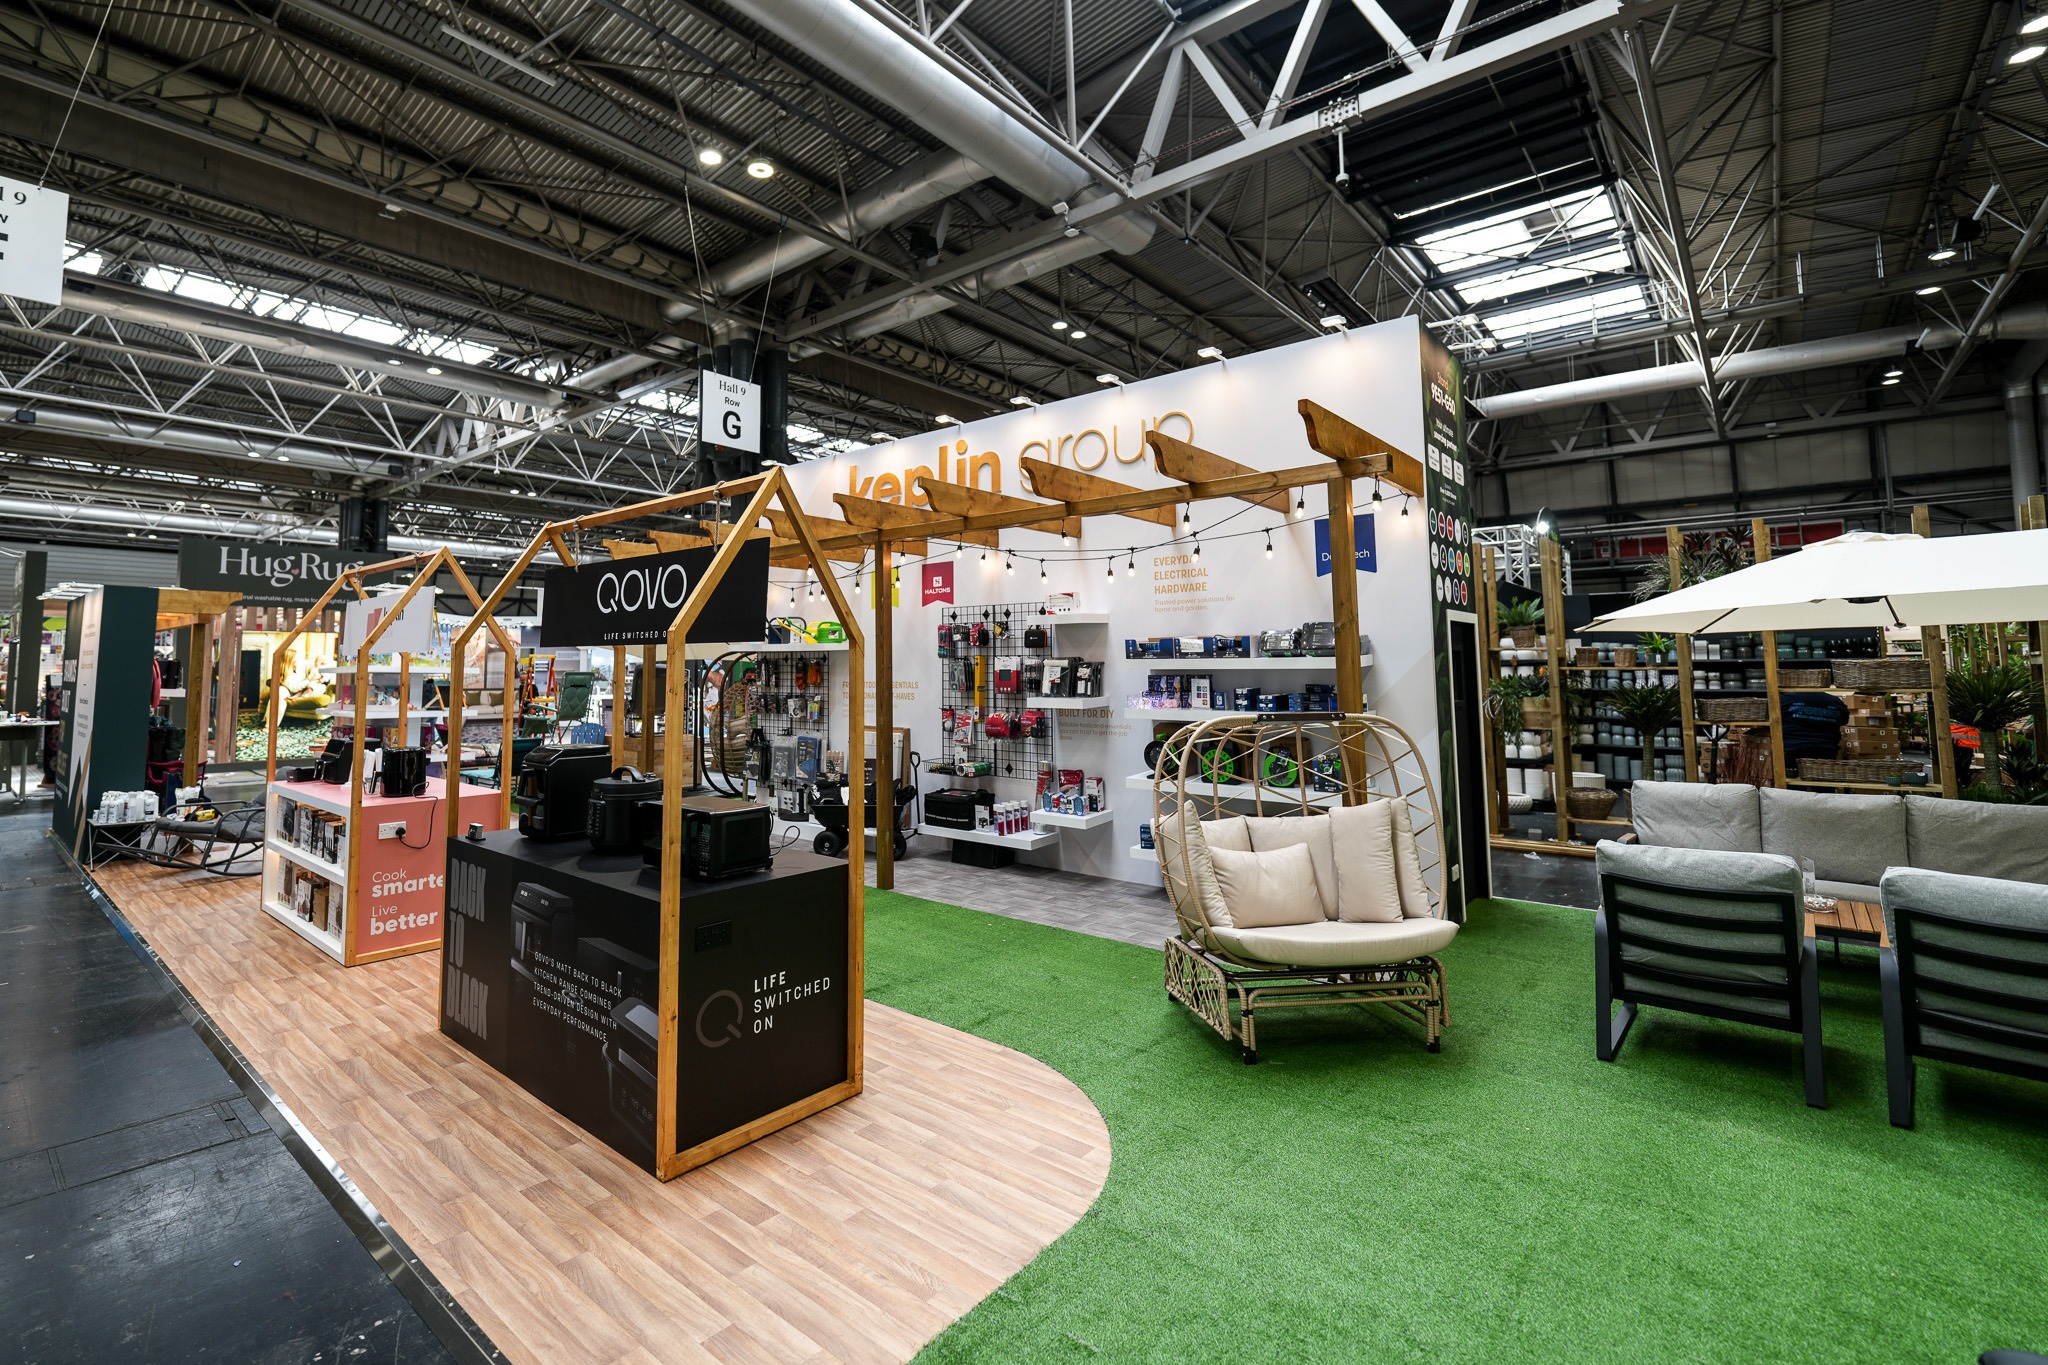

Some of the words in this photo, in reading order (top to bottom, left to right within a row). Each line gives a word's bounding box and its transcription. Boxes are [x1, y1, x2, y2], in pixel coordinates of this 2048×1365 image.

[719, 380, 738, 394] Hall
[740, 387, 746, 396] 9
[724, 396, 741, 408] Row
[722, 410, 742, 440] G
[849, 439, 1001, 508] keplin
[219, 546, 296, 588] Hug
[1154, 568, 1209, 580] ELECTRICAL
[597, 564, 687, 614] QOVO
[924, 587, 951, 595] HALTONS
[1154, 582, 1208, 594] HARDWARE
[1176, 599, 1197, 607] power
[604, 632, 619, 640] LIFE
[622, 631, 659, 640] SWITCHED
[1059, 709, 1080, 717] BUILT
[1082, 709, 1098, 718] FOR
[1100, 709, 1115, 718] DIY
[372, 868, 407, 883] Cook
[450, 857, 487, 923] BACK
[372, 905, 398, 917] Live
[370, 911, 438, 936] better
[449, 910, 465, 968] TO
[534, 967, 557, 984] KITCHEN
[559, 978, 578, 995] RANGE
[580, 988, 612, 1010] COMBINES
[556, 961, 572, 975] MATT
[573, 968, 589, 983] BACK
[591, 976, 599, 987] TO
[601, 981, 622, 998] BLACK
[754, 971, 786, 993] LIFE
[446, 963, 489, 1041] BLACK
[533, 981, 575, 1009] TREND-DRIVEN
[576, 1003, 599, 1021] DESIGN
[601, 1014, 617, 1030] WITH
[753, 977, 830, 1014] SWITCHED
[533, 997, 561, 1018] EVERYDAY
[753, 1015, 773, 1034] ON
